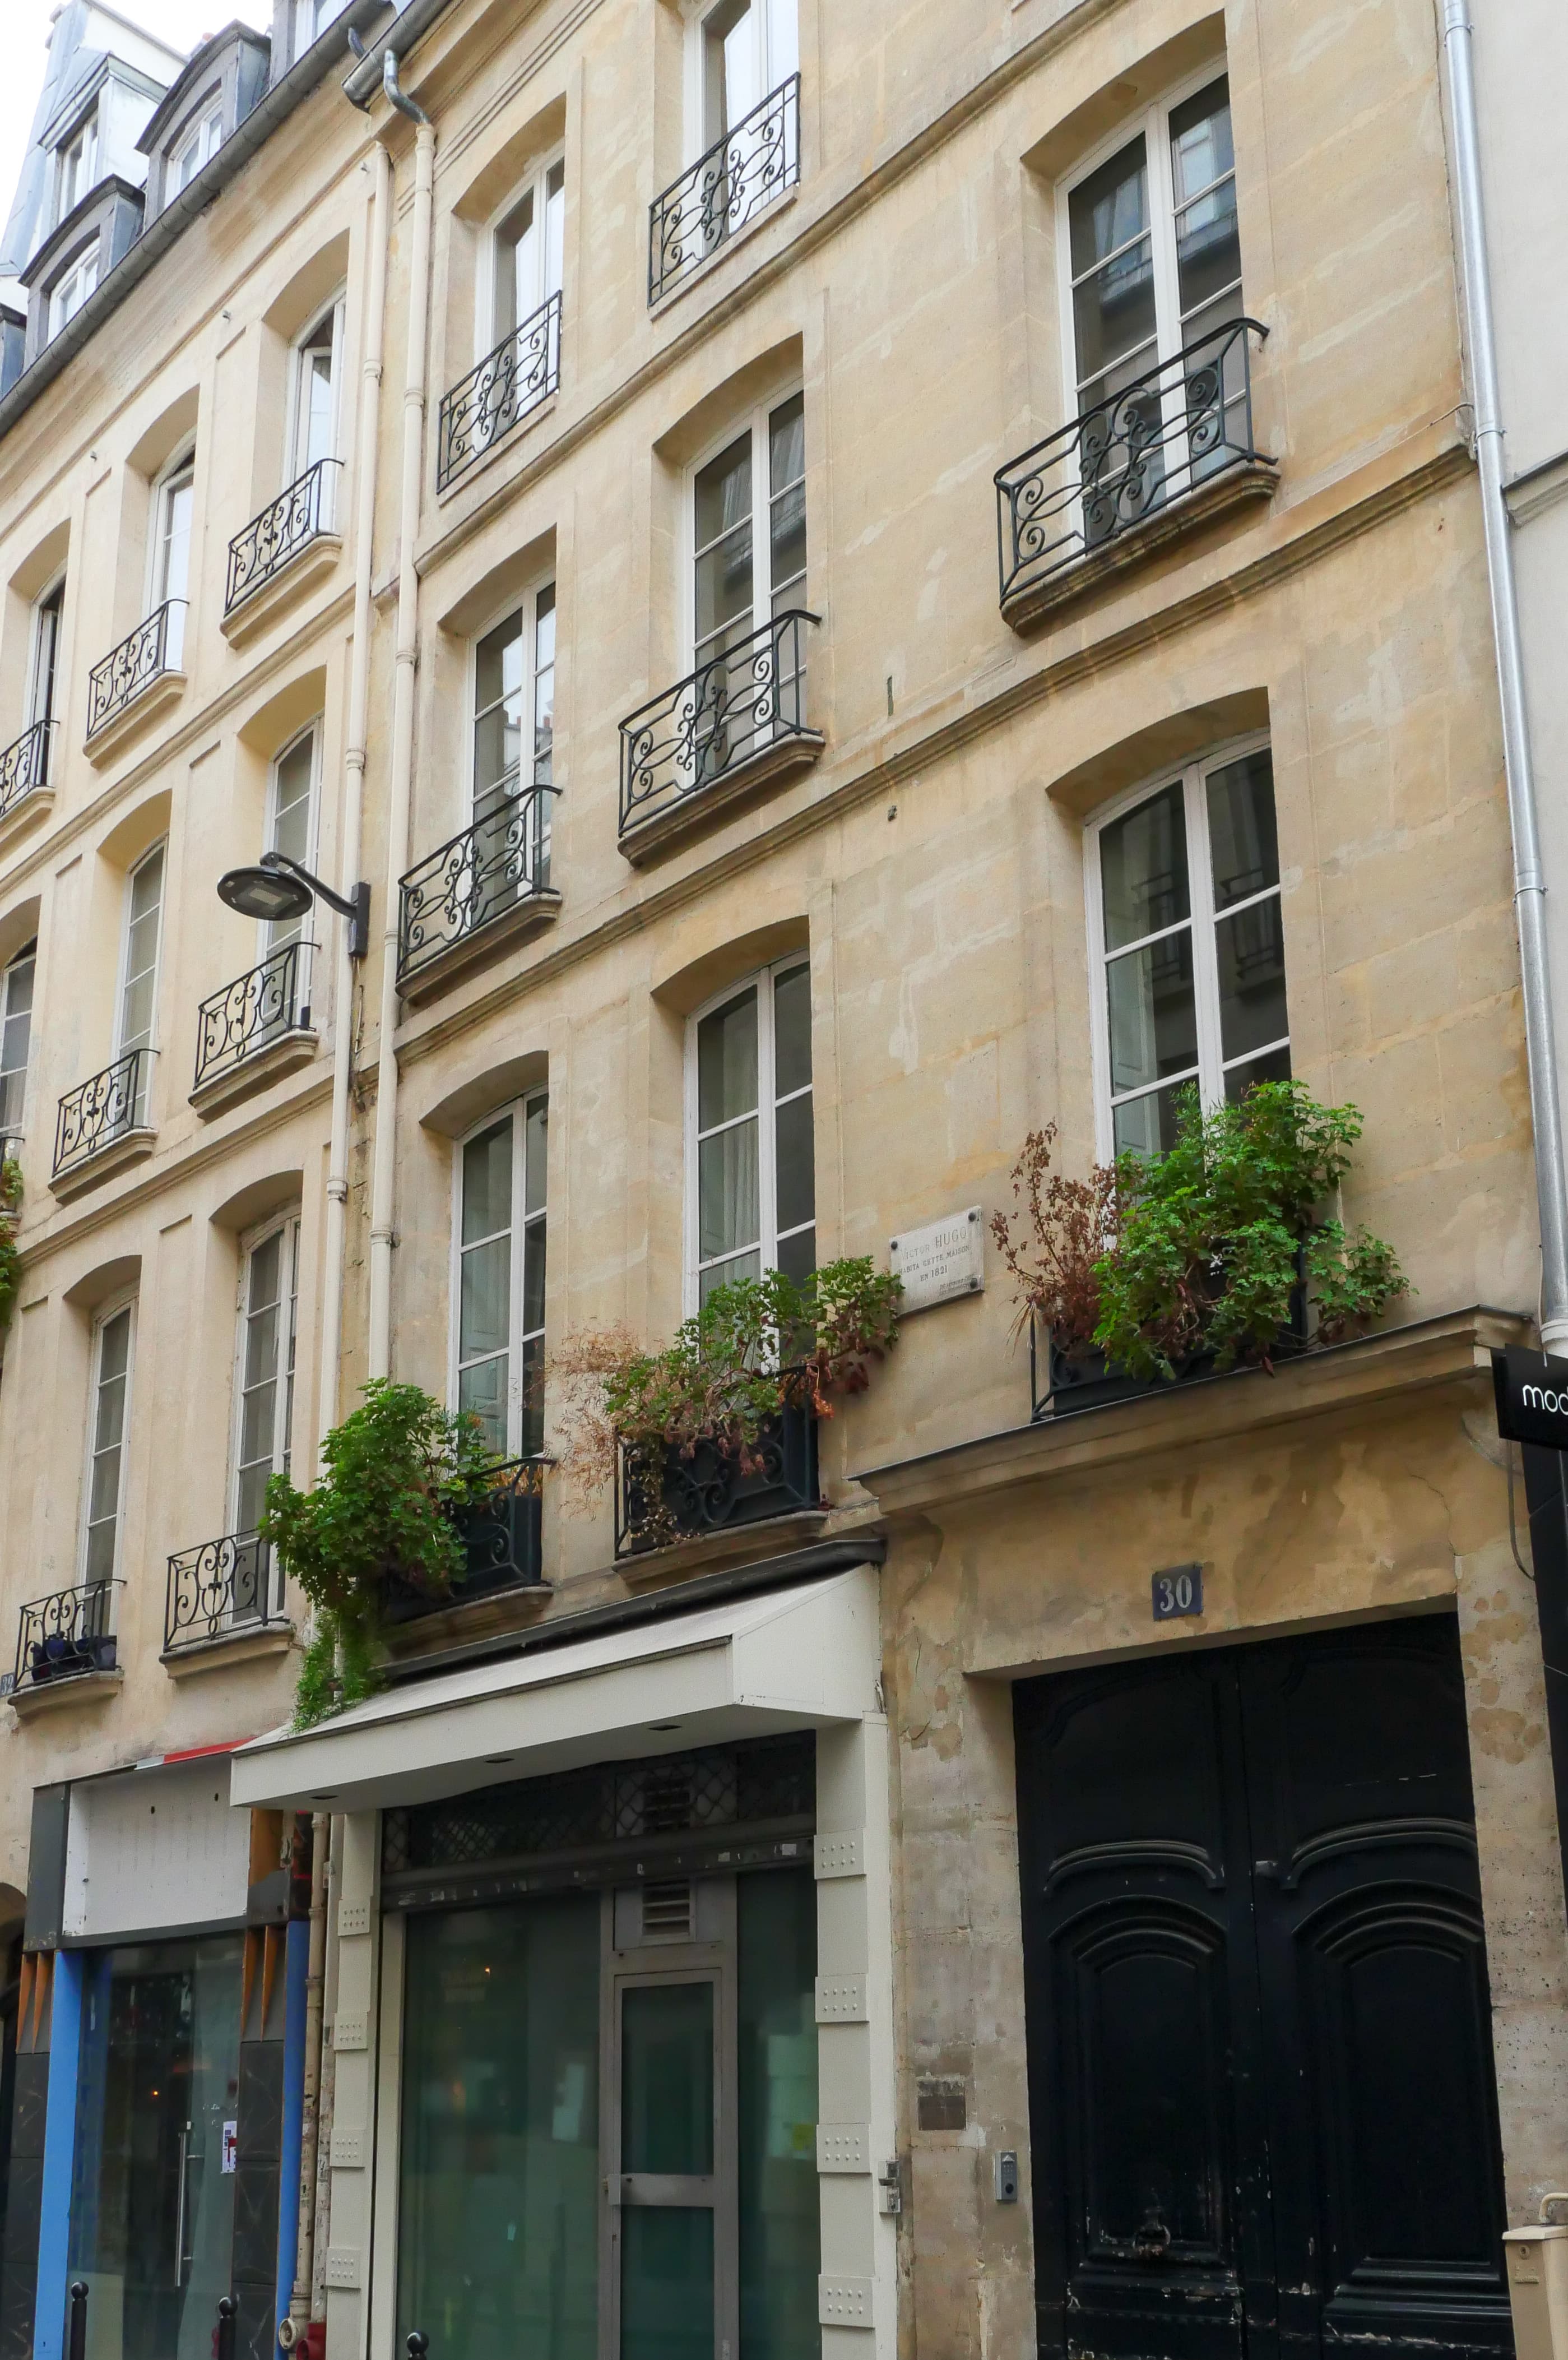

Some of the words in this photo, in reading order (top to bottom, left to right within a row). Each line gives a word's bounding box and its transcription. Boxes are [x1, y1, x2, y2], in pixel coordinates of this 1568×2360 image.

[935, 1226, 967, 1248] HUGO
[897, 1262, 920, 1275] HABITA
[947, 1244, 970, 1258] MAISON
[920, 1273, 929, 1282] EN
[931, 1265, 948, 1278] 1821
[1160, 1575, 1193, 1612] 30
